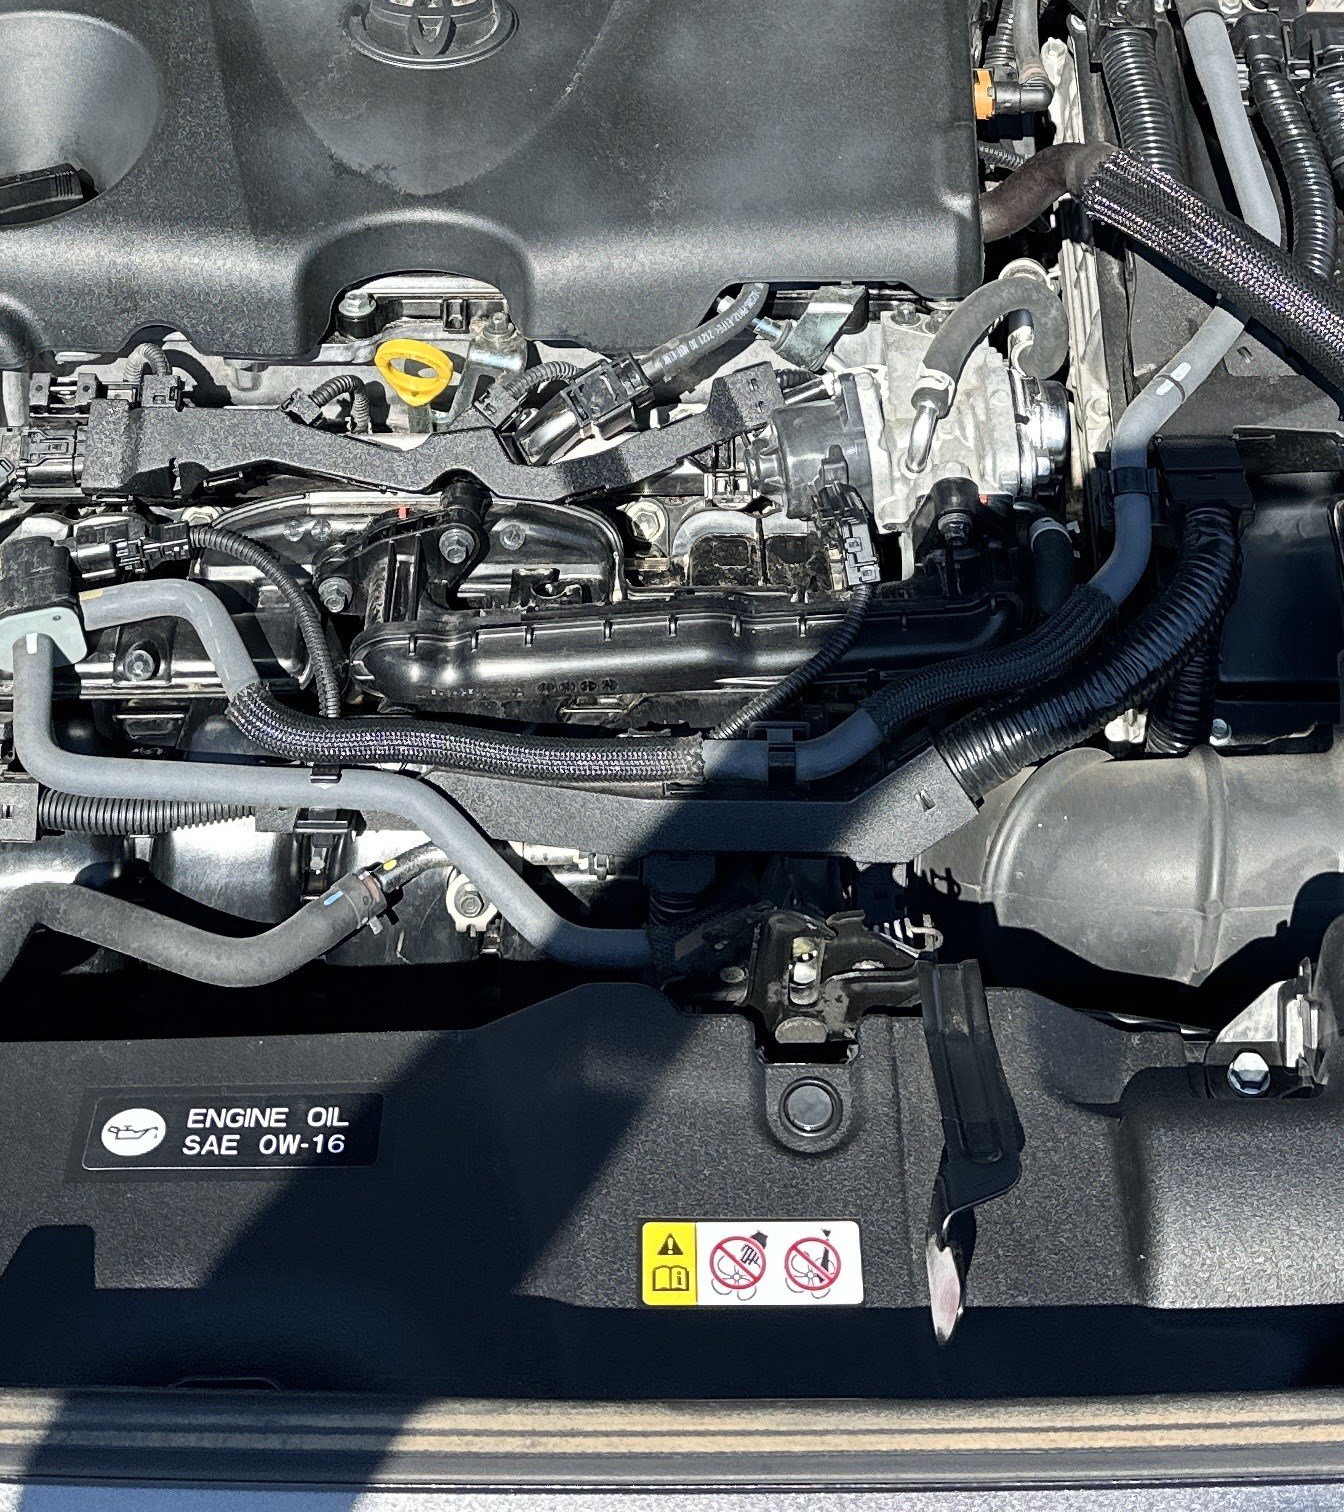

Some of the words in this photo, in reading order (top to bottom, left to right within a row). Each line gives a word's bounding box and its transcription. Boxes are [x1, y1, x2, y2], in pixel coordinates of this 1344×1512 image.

[187, 1107, 289, 1128] ENGINE
[307, 1106, 349, 1128] OIL
[182, 1134, 240, 1155] SAE
[259, 1133, 346, 1155] 0W-16
